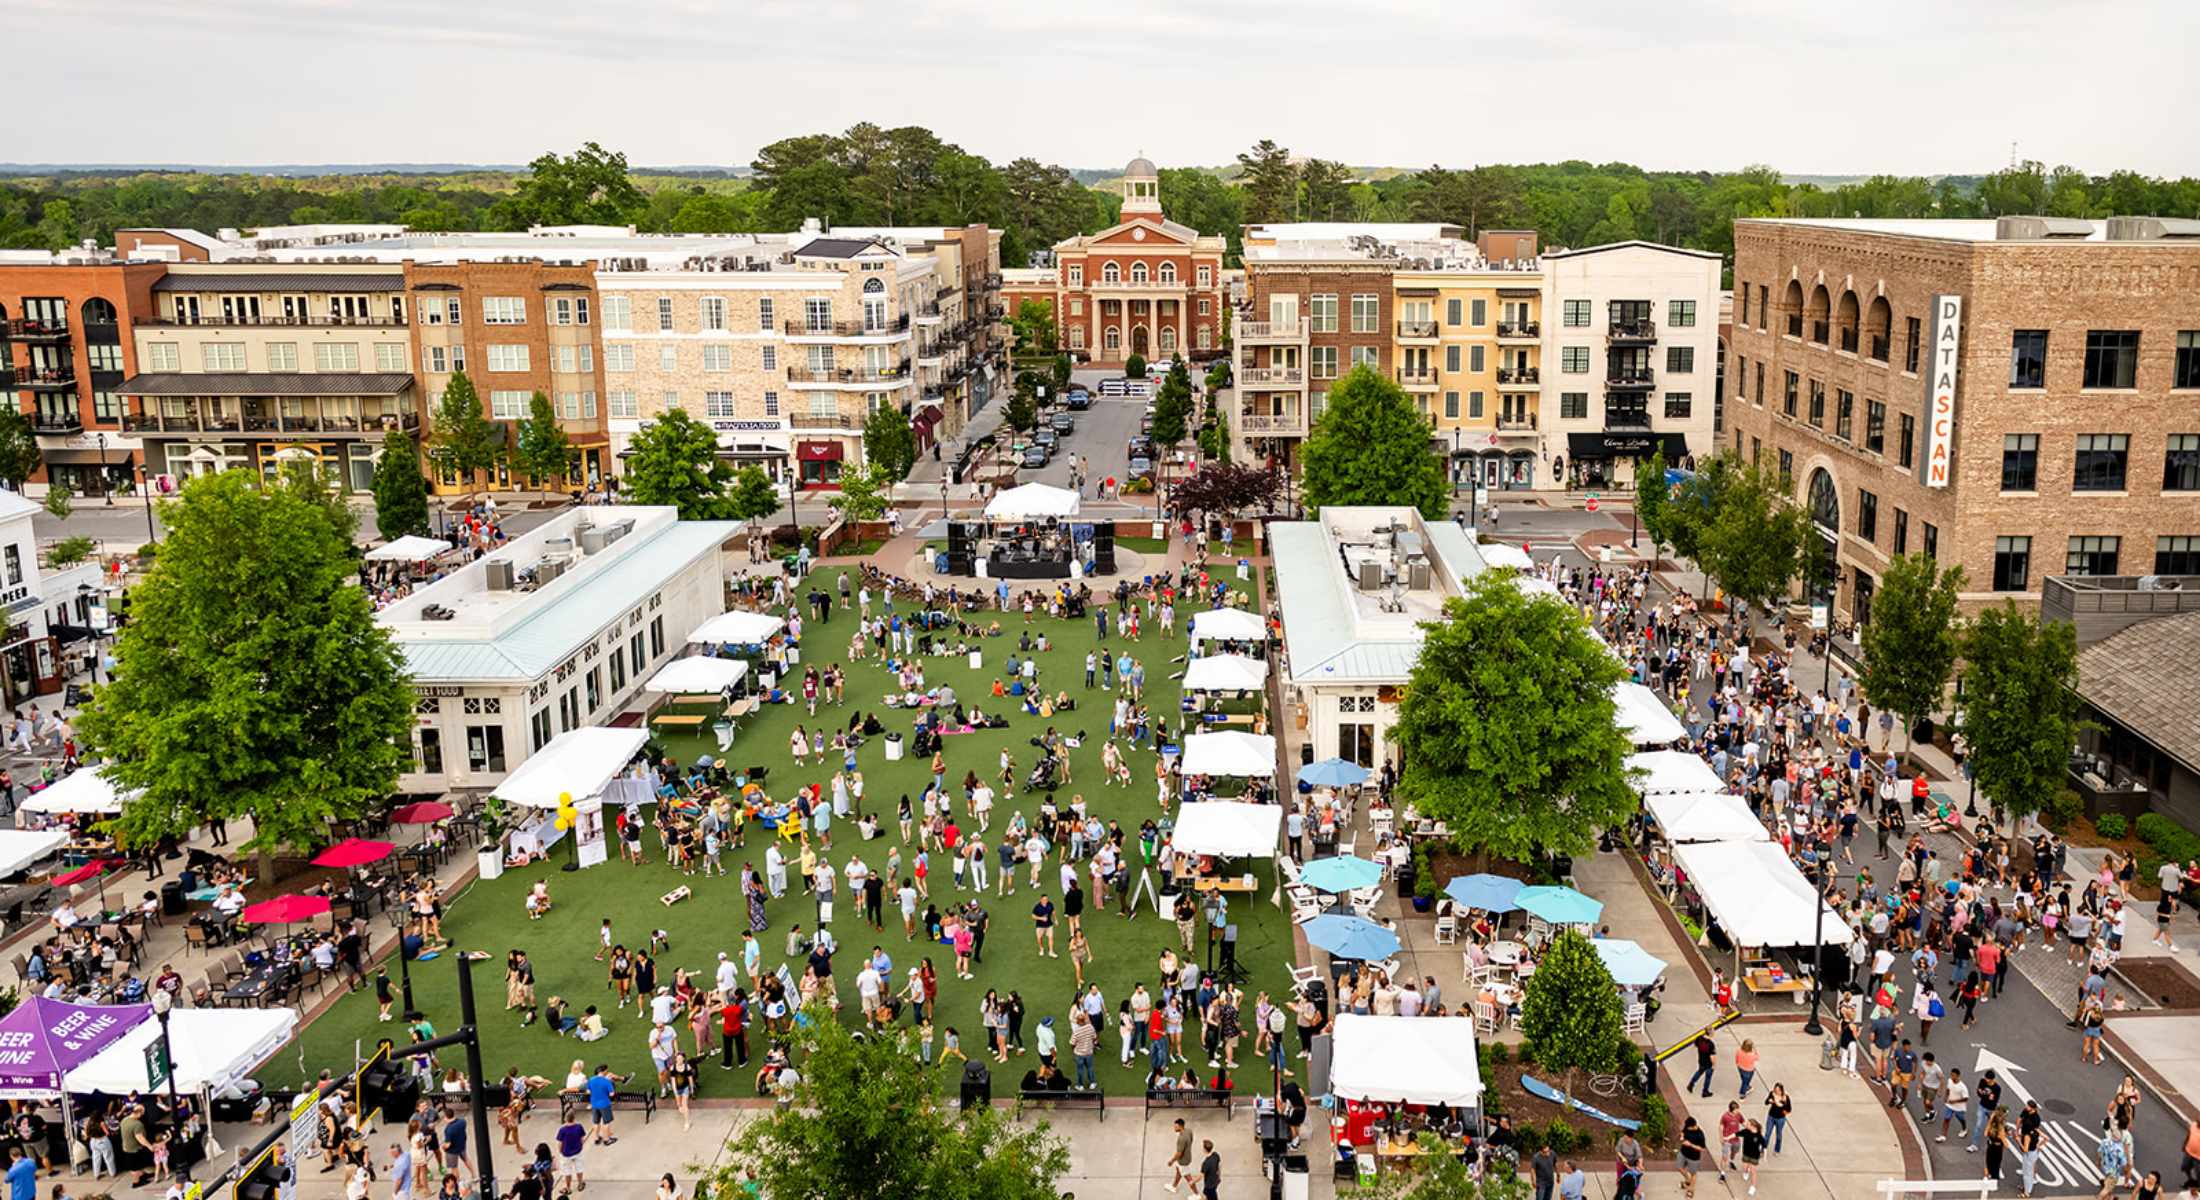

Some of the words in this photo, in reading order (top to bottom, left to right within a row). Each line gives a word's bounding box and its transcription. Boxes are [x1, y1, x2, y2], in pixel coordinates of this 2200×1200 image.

[1931, 301, 1957, 482] DATASCAN
[0, 586, 27, 604] PEER
[50, 1010, 92, 1038] BEER
[63, 1040, 82, 1051] &
[73, 1013, 118, 1041] WINE
[0, 1031, 35, 1048] EER
